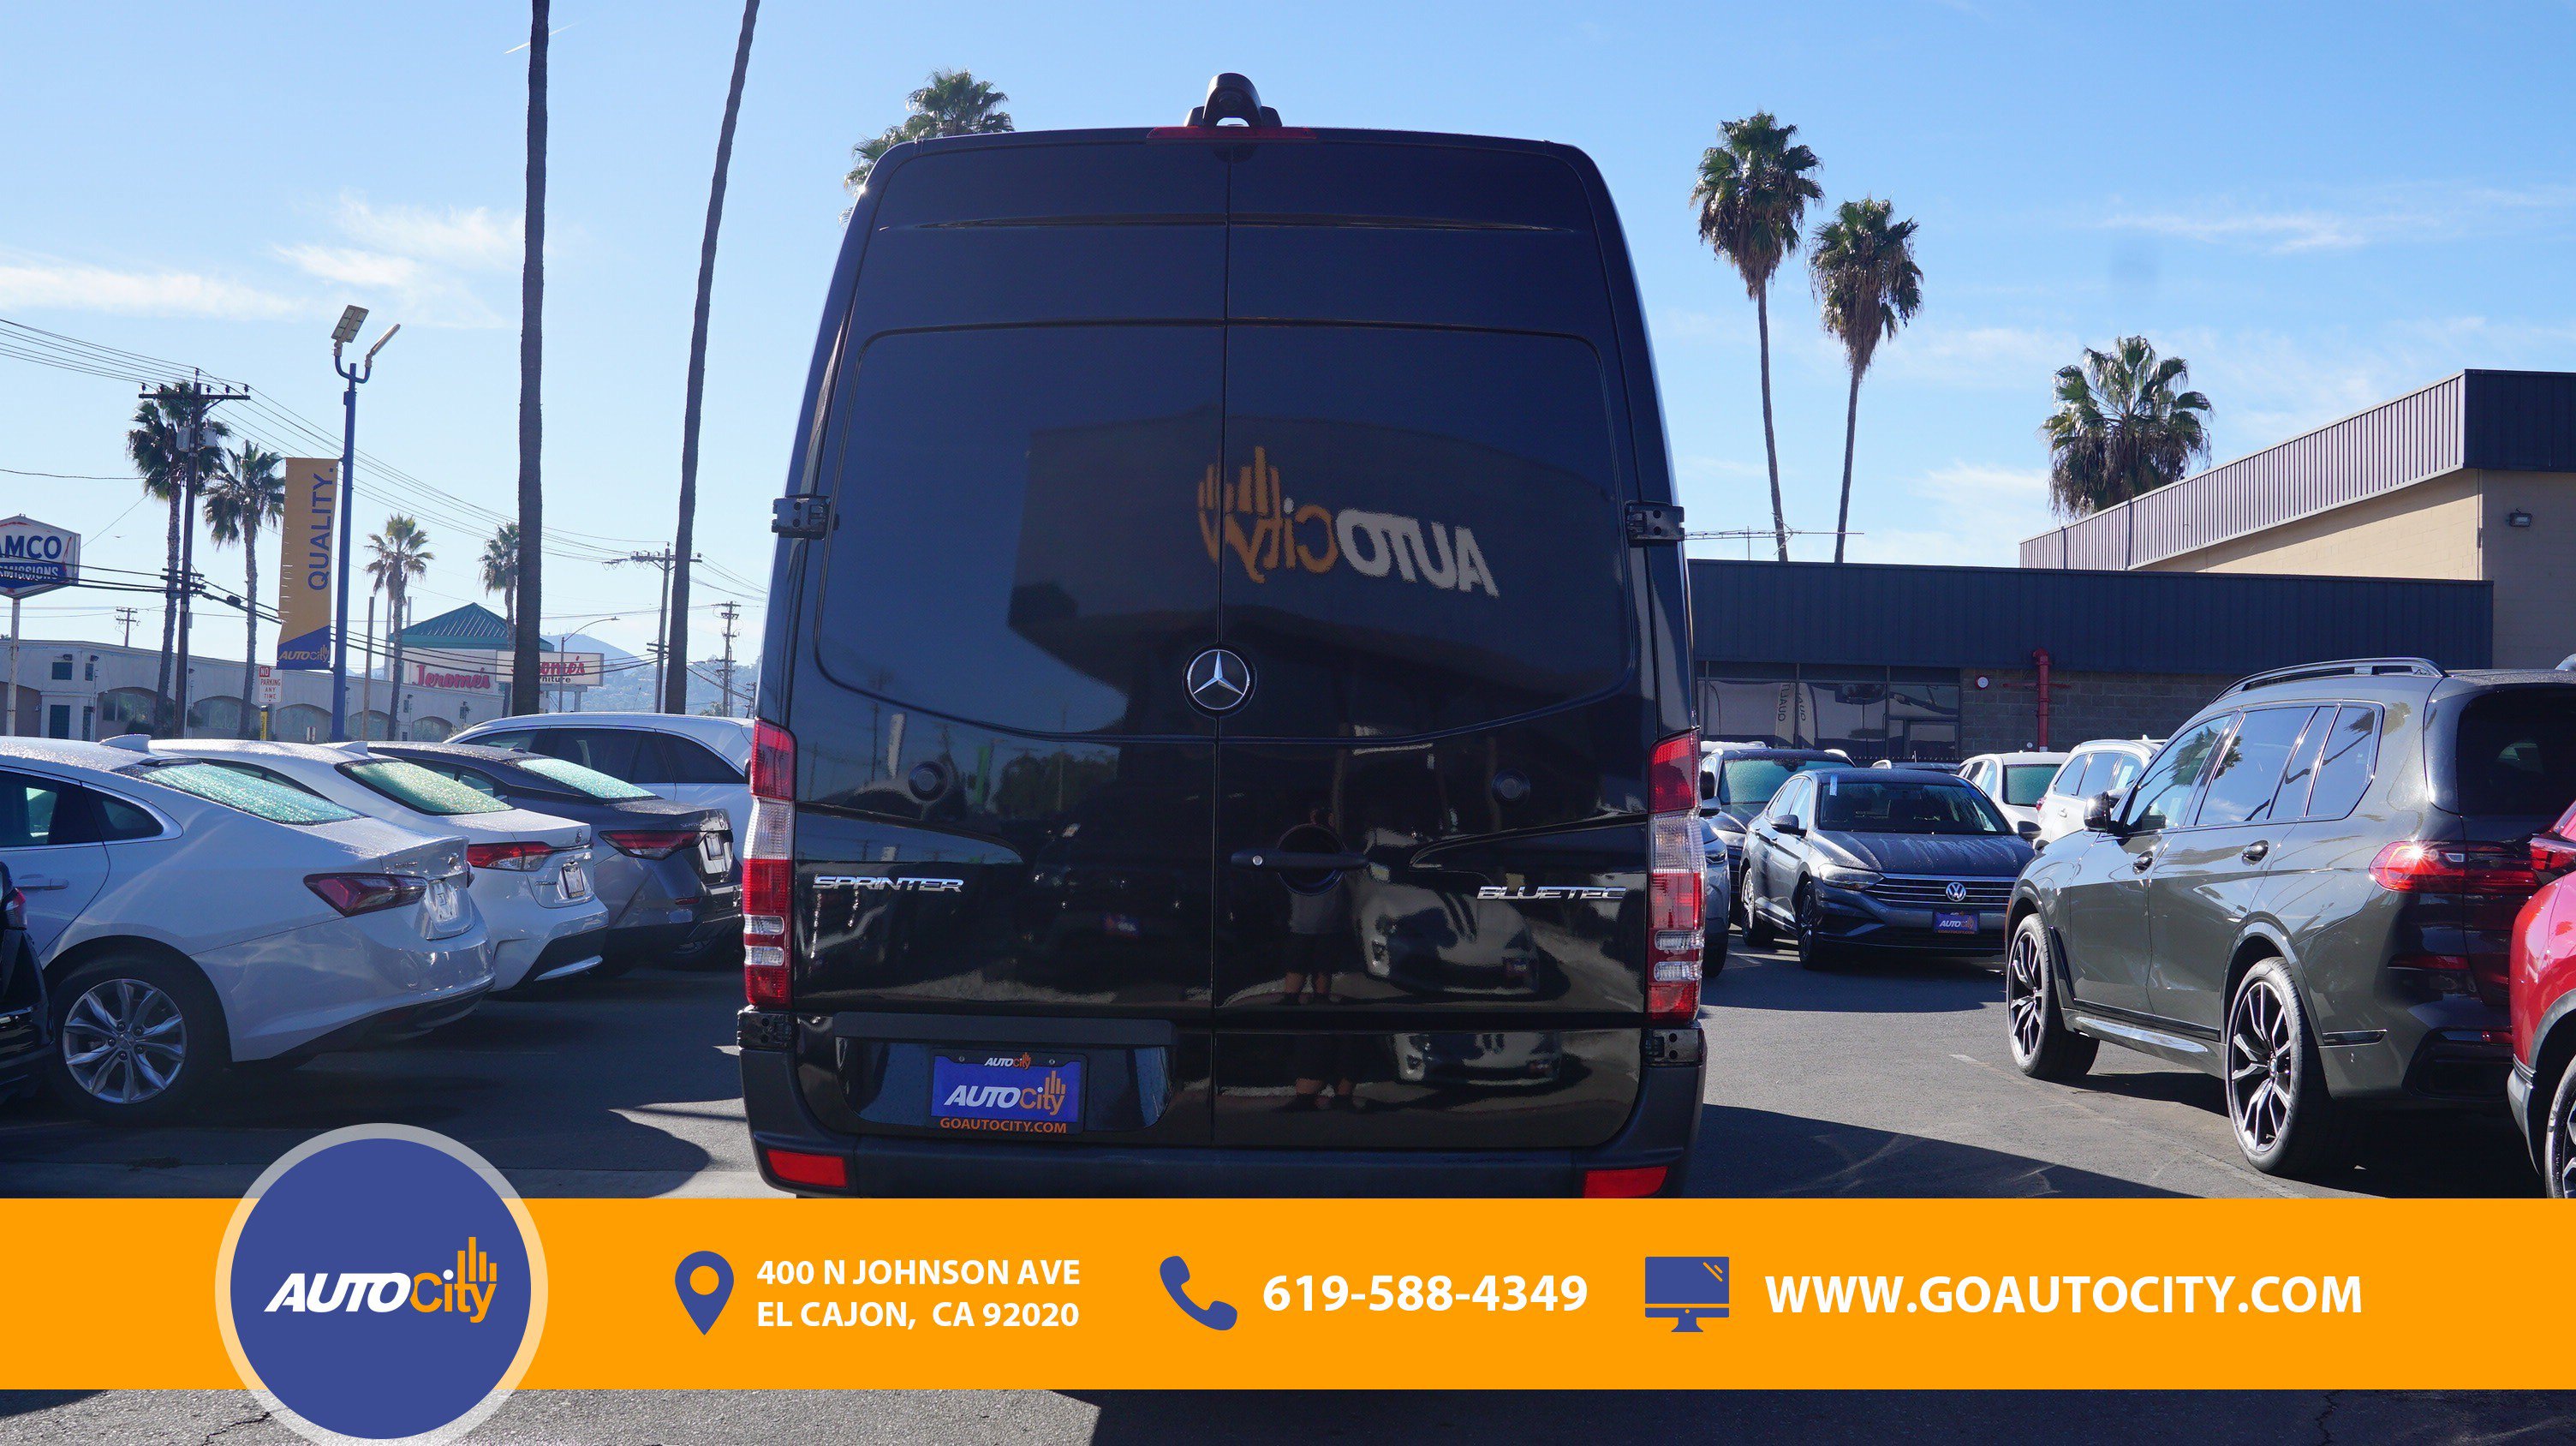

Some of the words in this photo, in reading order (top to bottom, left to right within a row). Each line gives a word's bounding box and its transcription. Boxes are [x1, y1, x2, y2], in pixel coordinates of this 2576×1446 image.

[0, 535, 62, 559] MCO
[0, 565, 58, 580] MISSIONS
[260, 666, 269, 676] NO
[412, 665, 490, 689] Jerome's
[813, 875, 964, 893] SPRINTER
[1477, 886, 1626, 900] BLUETEC
[940, 1116, 1068, 1134] GOAUTOCITY.COM
